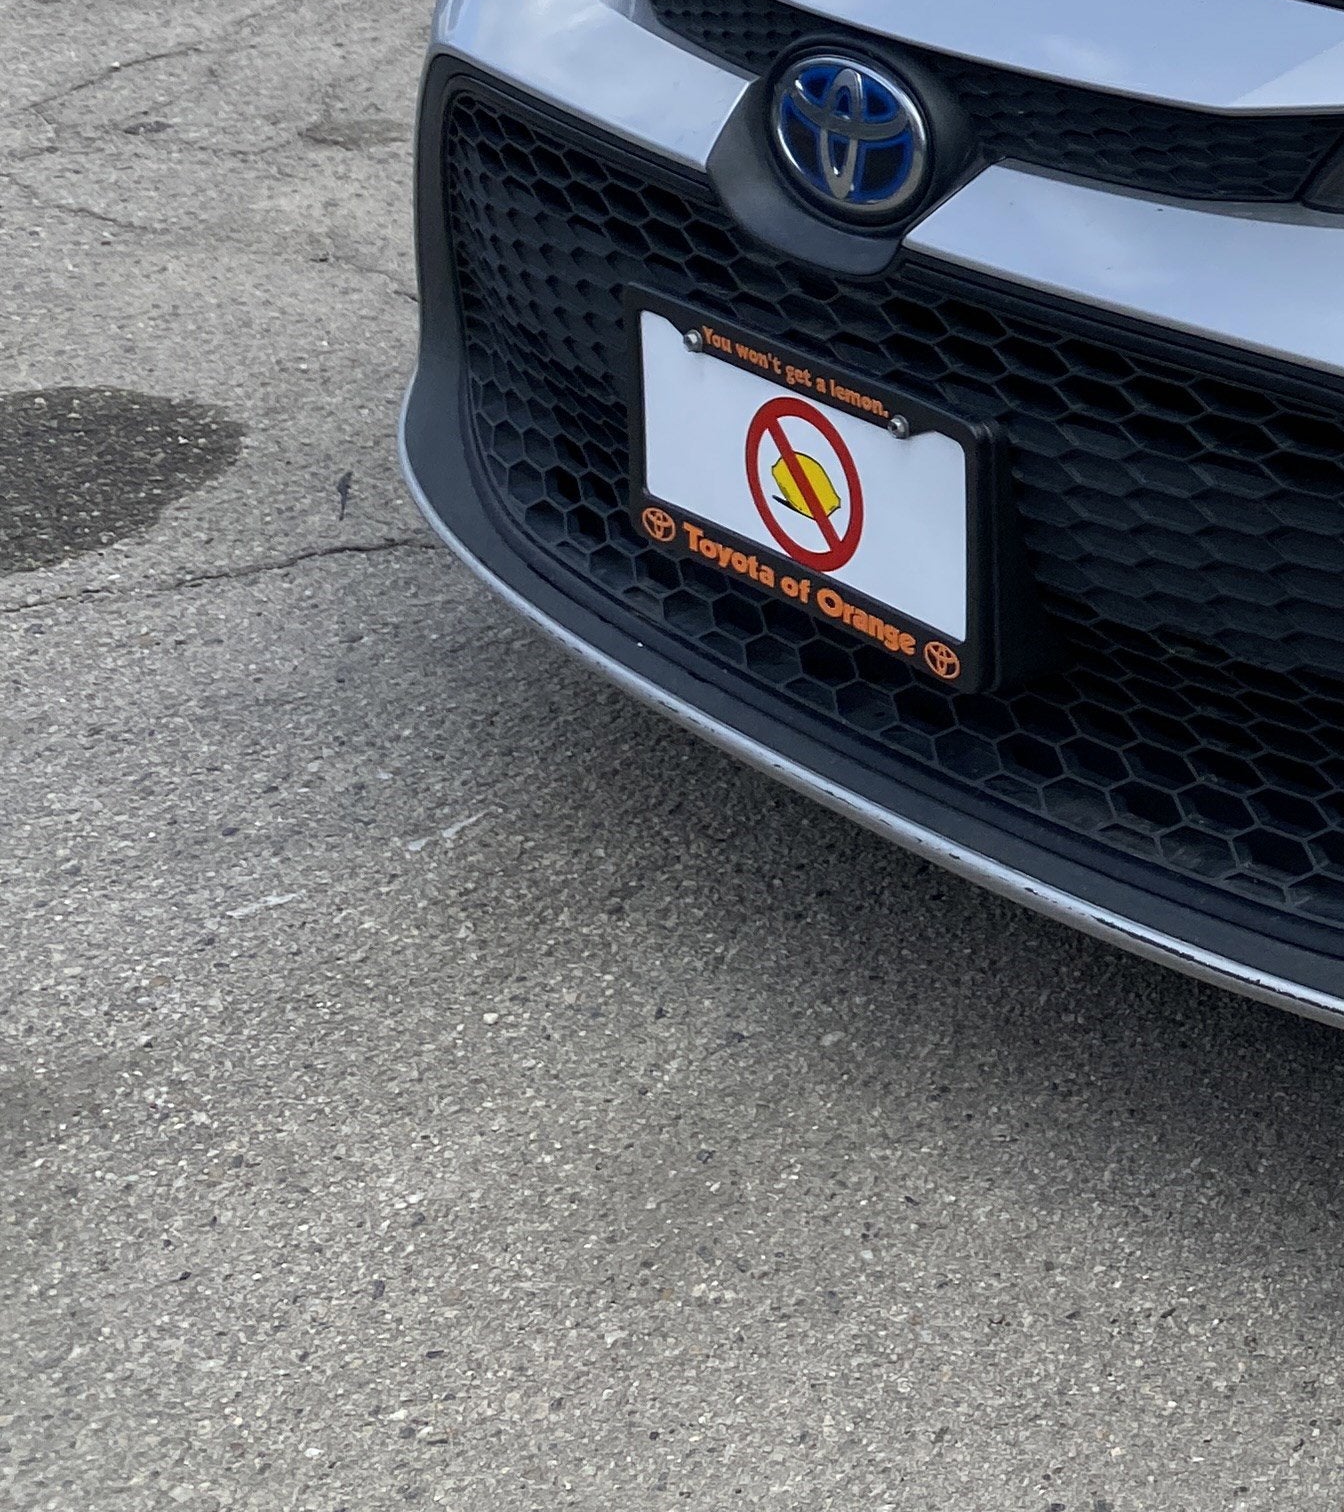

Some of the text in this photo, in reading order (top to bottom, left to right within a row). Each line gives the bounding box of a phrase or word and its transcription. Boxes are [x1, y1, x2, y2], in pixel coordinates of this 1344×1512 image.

[702, 325, 889, 419] You won't get a lemon.
[683, 521, 917, 656] Toyota of Orange
